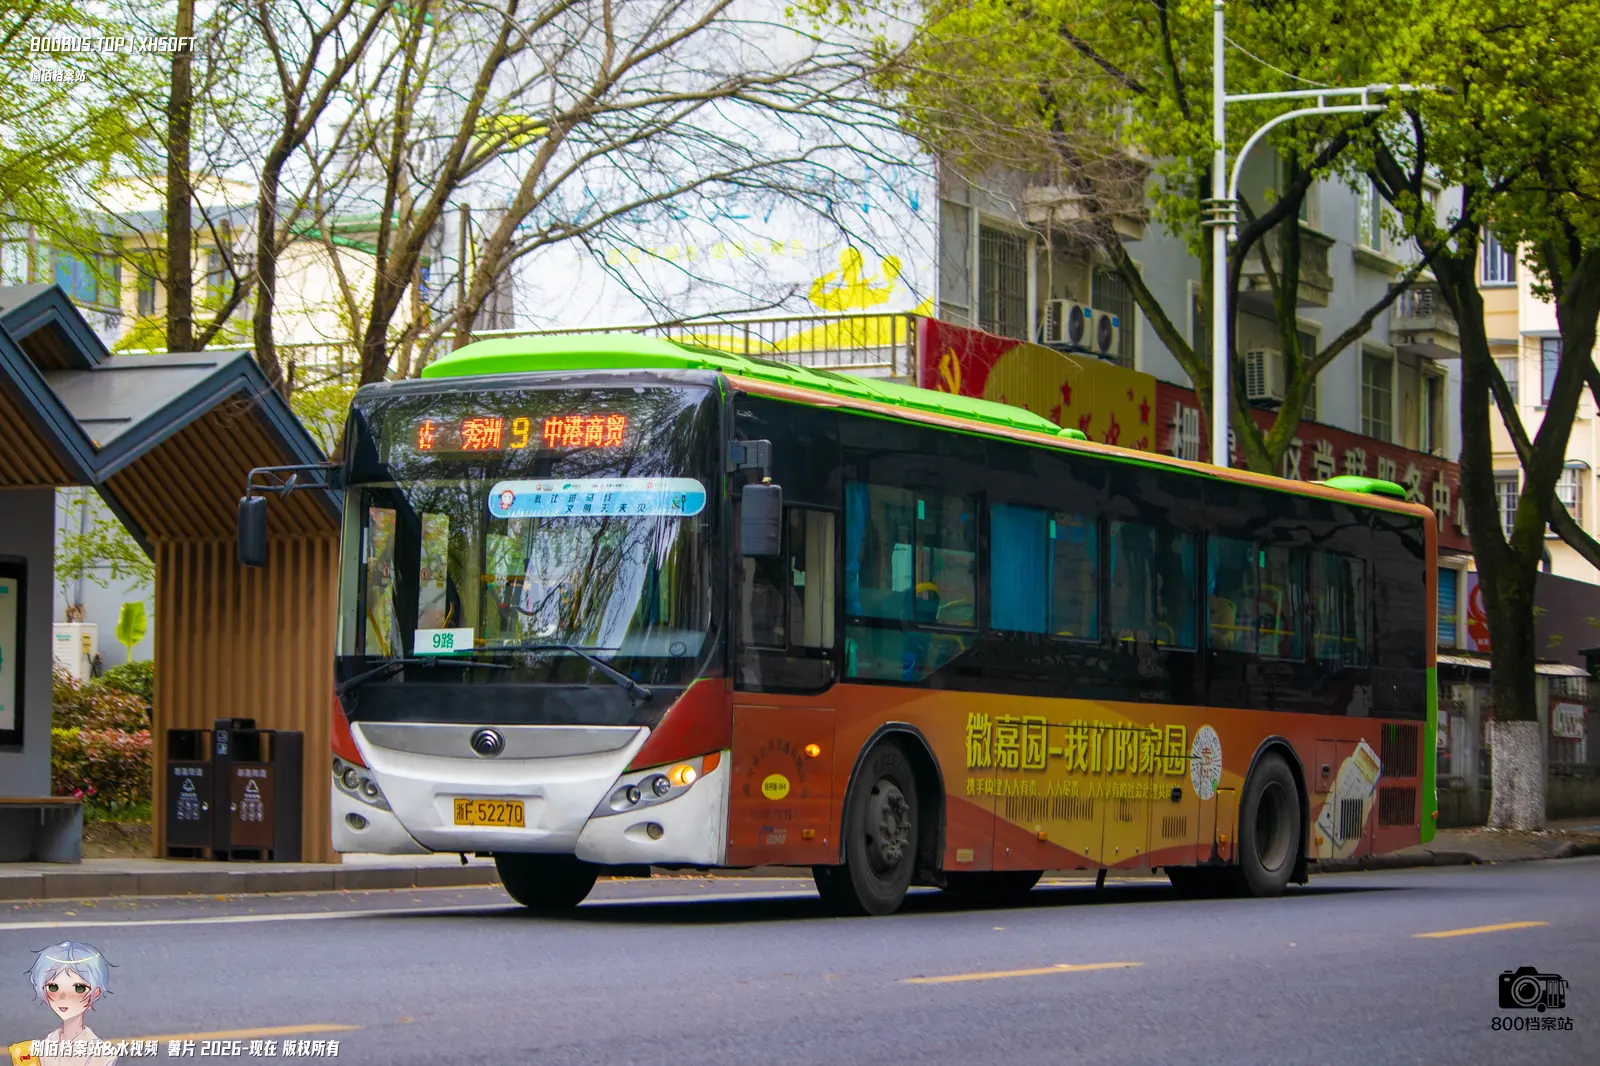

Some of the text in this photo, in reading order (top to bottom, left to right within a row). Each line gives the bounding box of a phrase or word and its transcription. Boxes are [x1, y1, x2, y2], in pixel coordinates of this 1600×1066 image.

[462, 417, 503, 449] 秀洲
[510, 416, 529, 449] 9
[543, 413, 627, 449] 中港商贸
[431, 632, 455, 650] 9路
